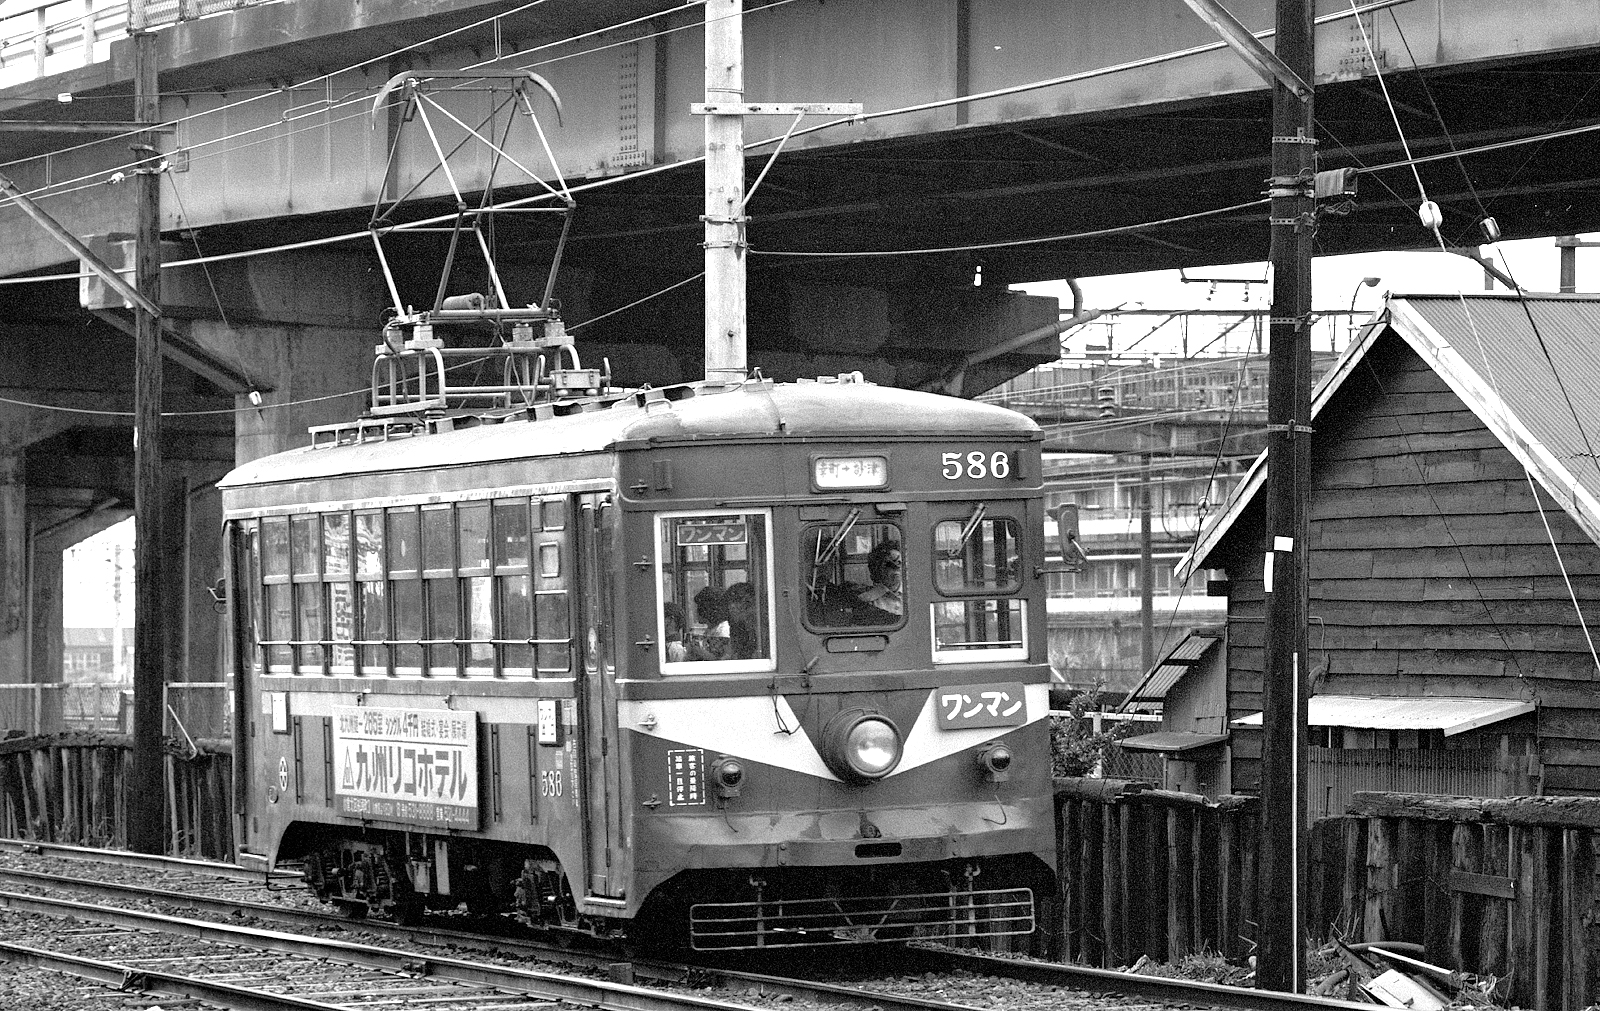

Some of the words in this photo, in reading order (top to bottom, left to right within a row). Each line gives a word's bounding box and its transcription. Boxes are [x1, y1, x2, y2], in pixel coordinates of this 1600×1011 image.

[942, 451, 1009, 480] 586
[680, 525, 744, 542] ワンマン
[941, 691, 1022, 720] ワンマン
[355, 743, 468, 801] 九州リコホテル
